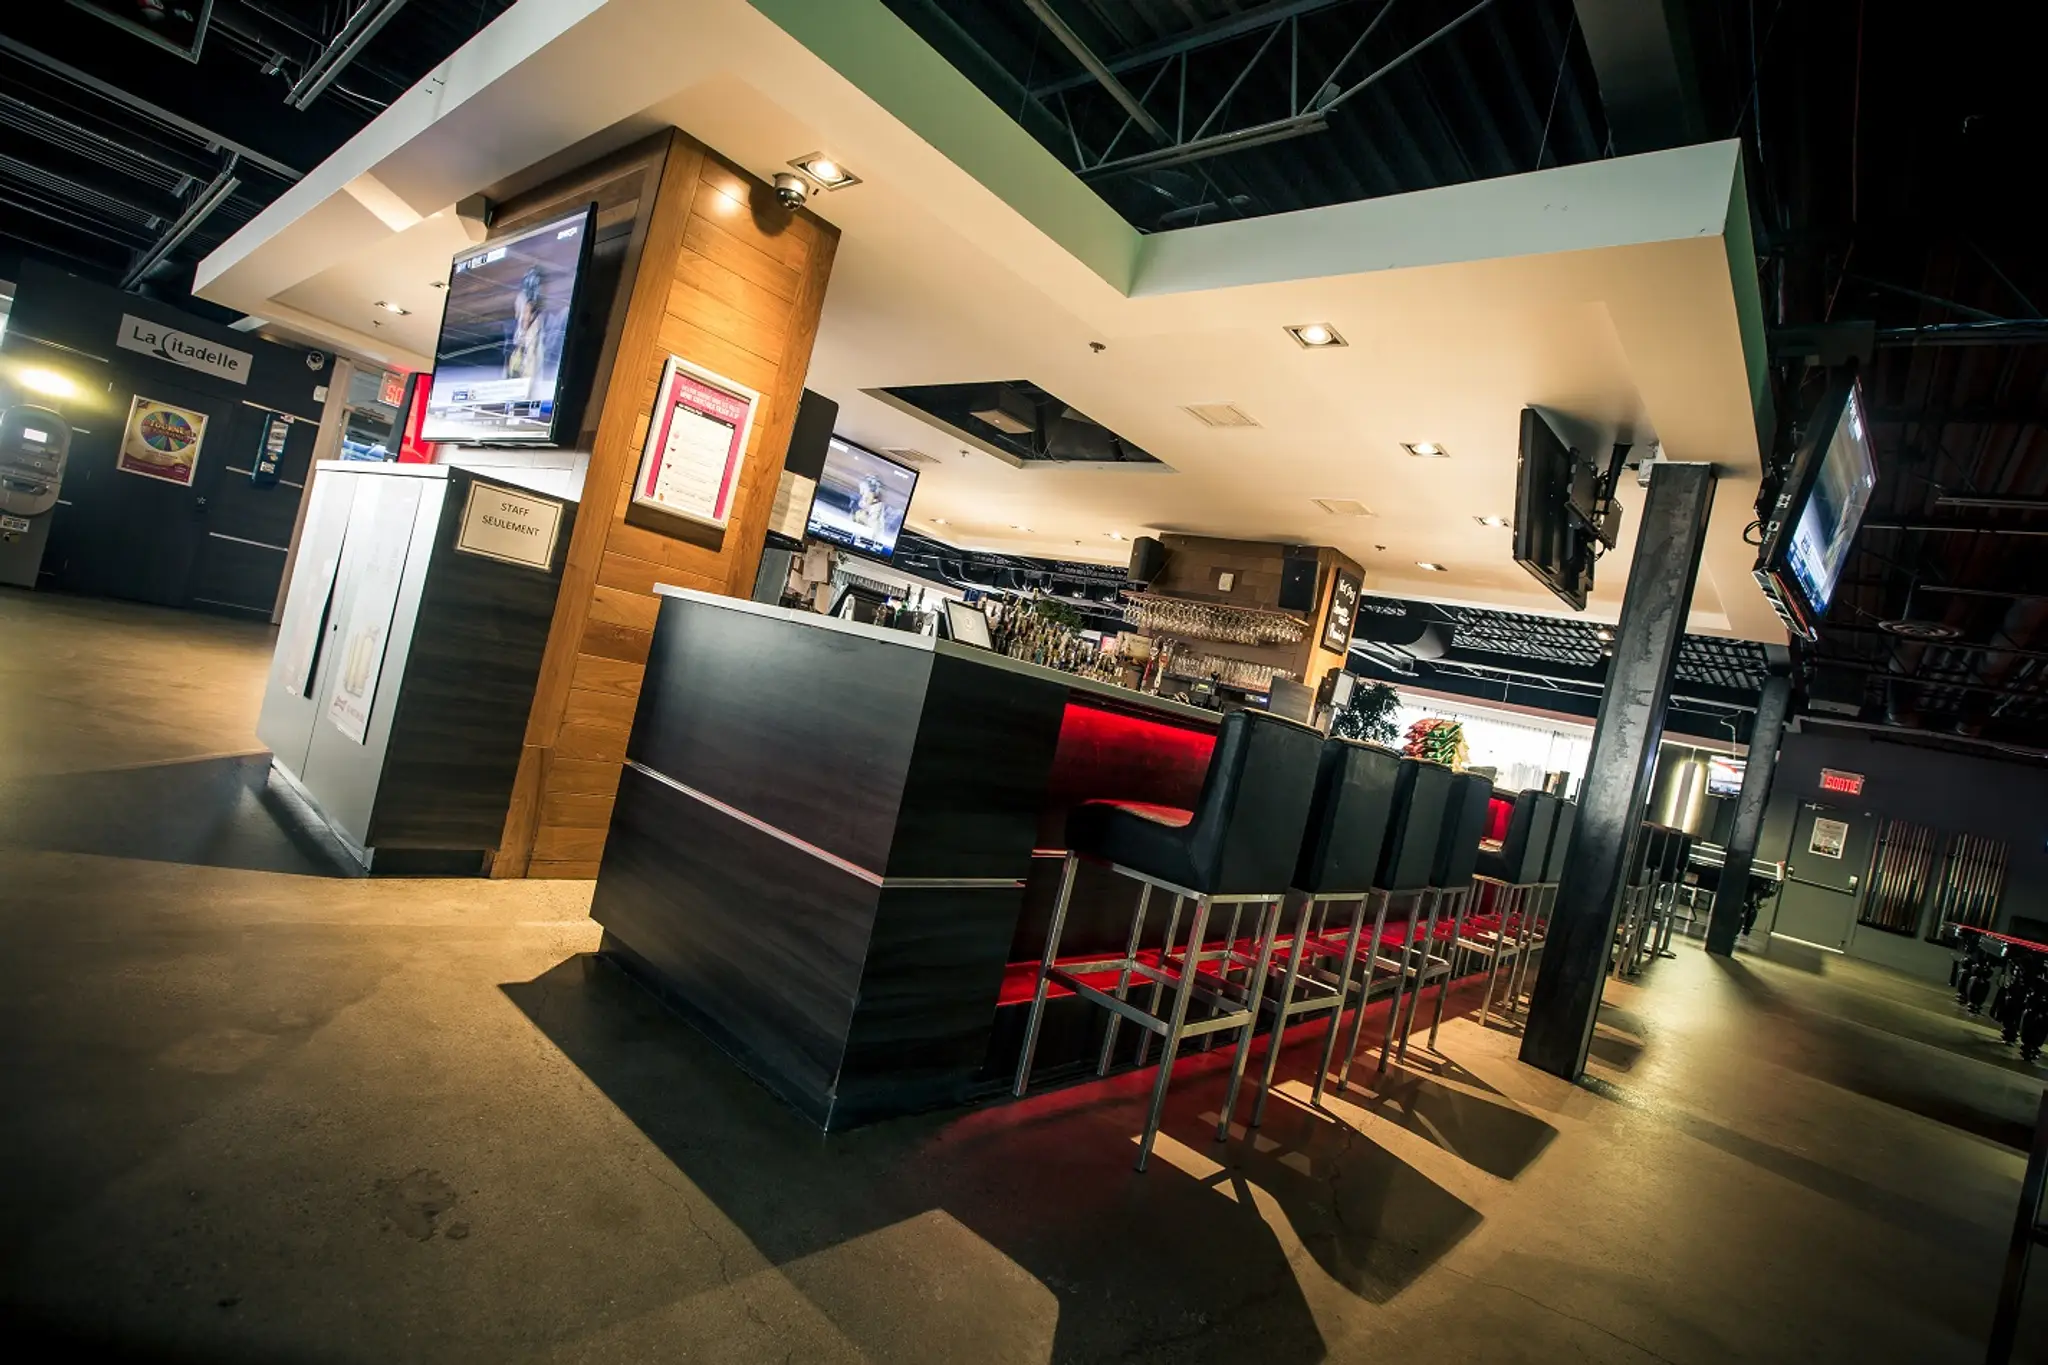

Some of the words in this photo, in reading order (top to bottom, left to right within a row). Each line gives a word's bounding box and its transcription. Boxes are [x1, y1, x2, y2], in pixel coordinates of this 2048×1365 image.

[133, 325, 156, 346] La
[153, 331, 239, 371] Citadelle
[500, 502, 530, 516] STAFF
[482, 514, 540, 536] SEULEMENT
[1825, 777, 1860, 794] SORTIE
